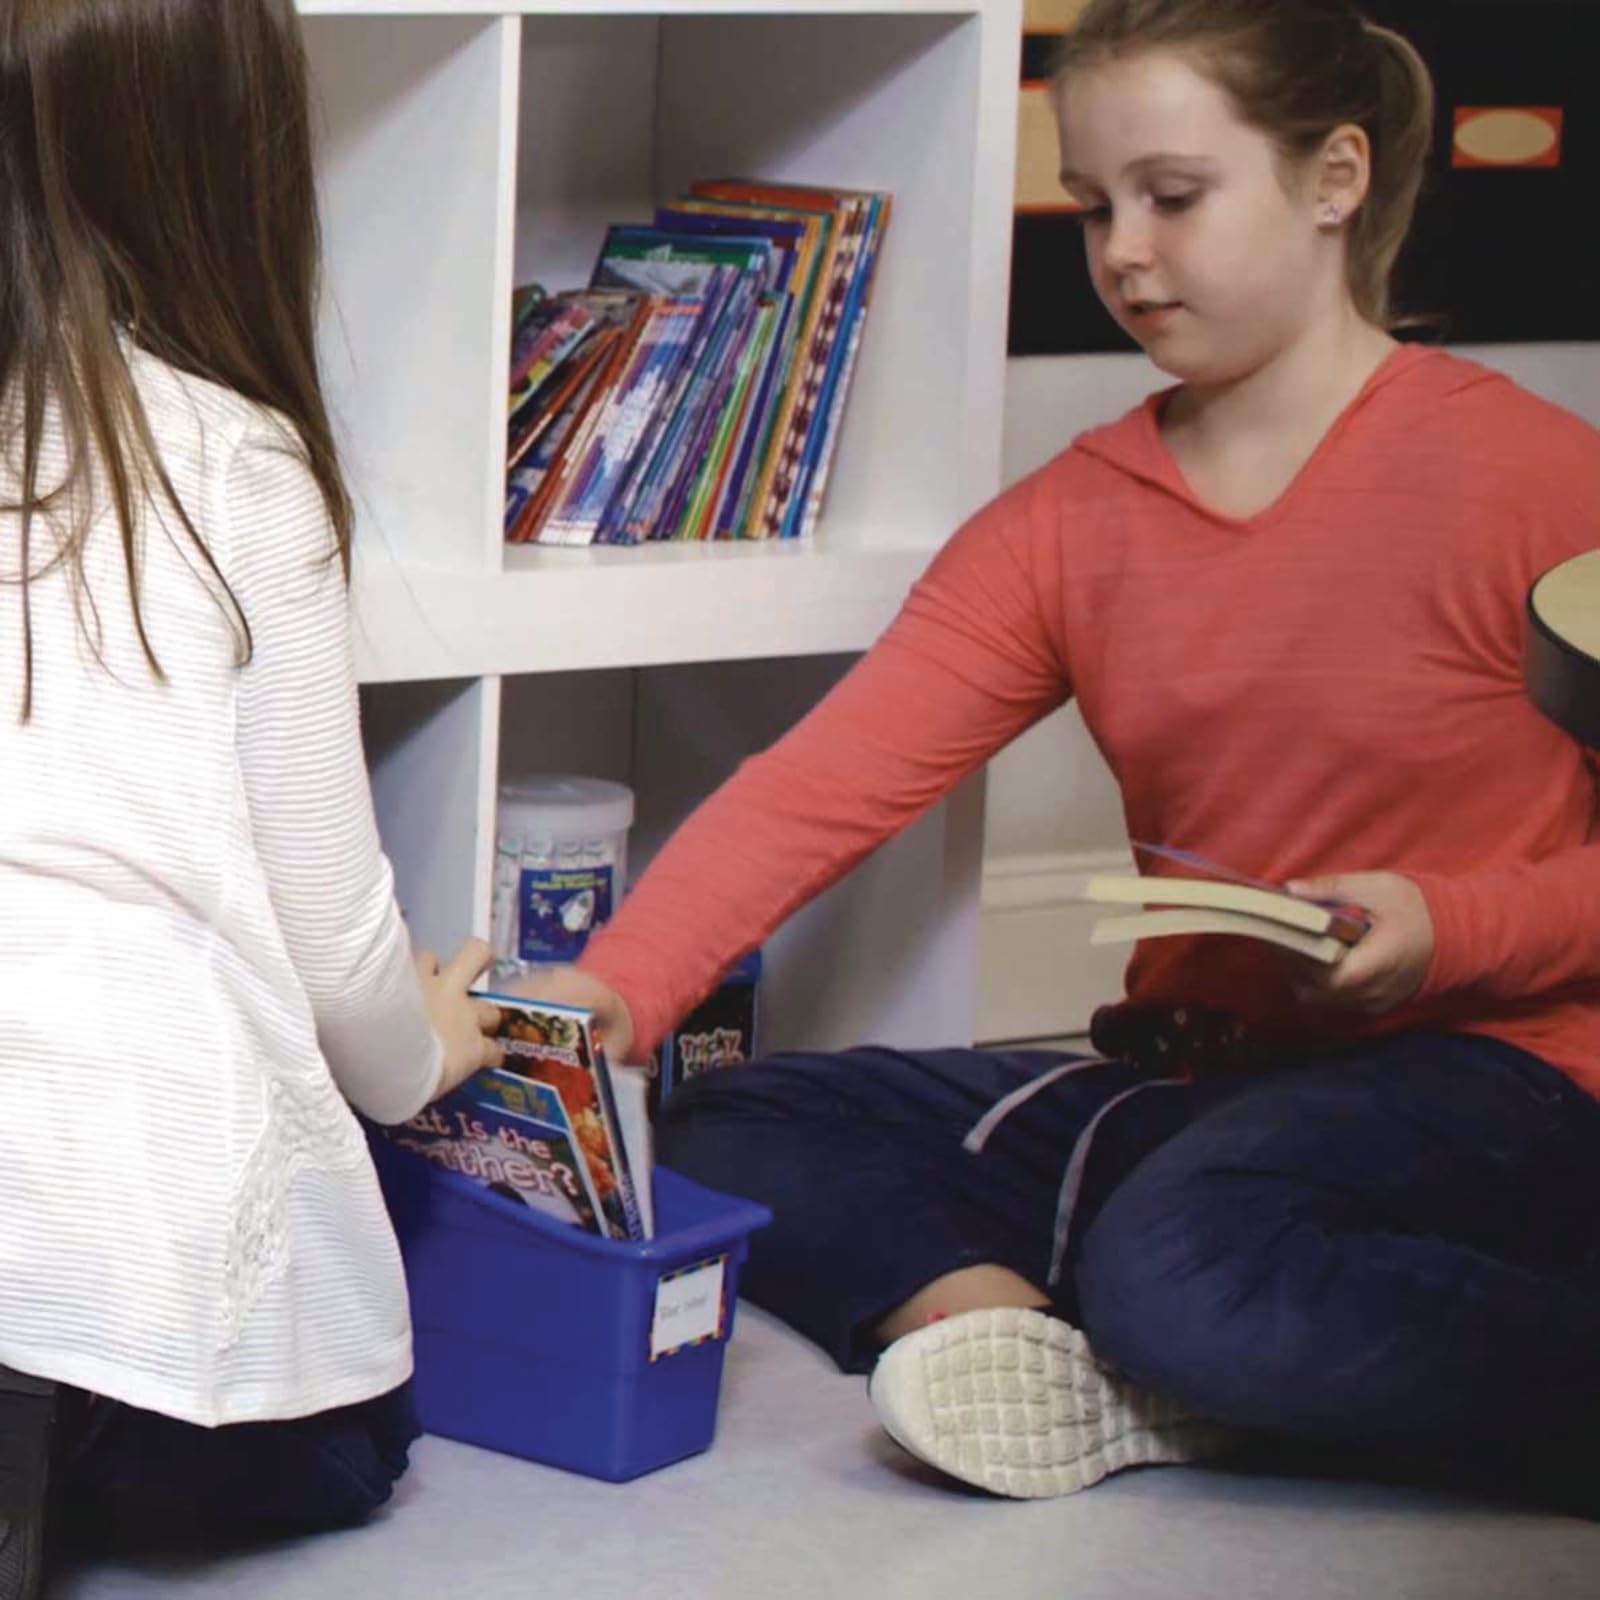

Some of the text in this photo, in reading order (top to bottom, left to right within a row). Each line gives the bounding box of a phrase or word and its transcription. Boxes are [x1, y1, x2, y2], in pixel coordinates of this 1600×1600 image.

[405, 1108, 552, 1160] at Is the
